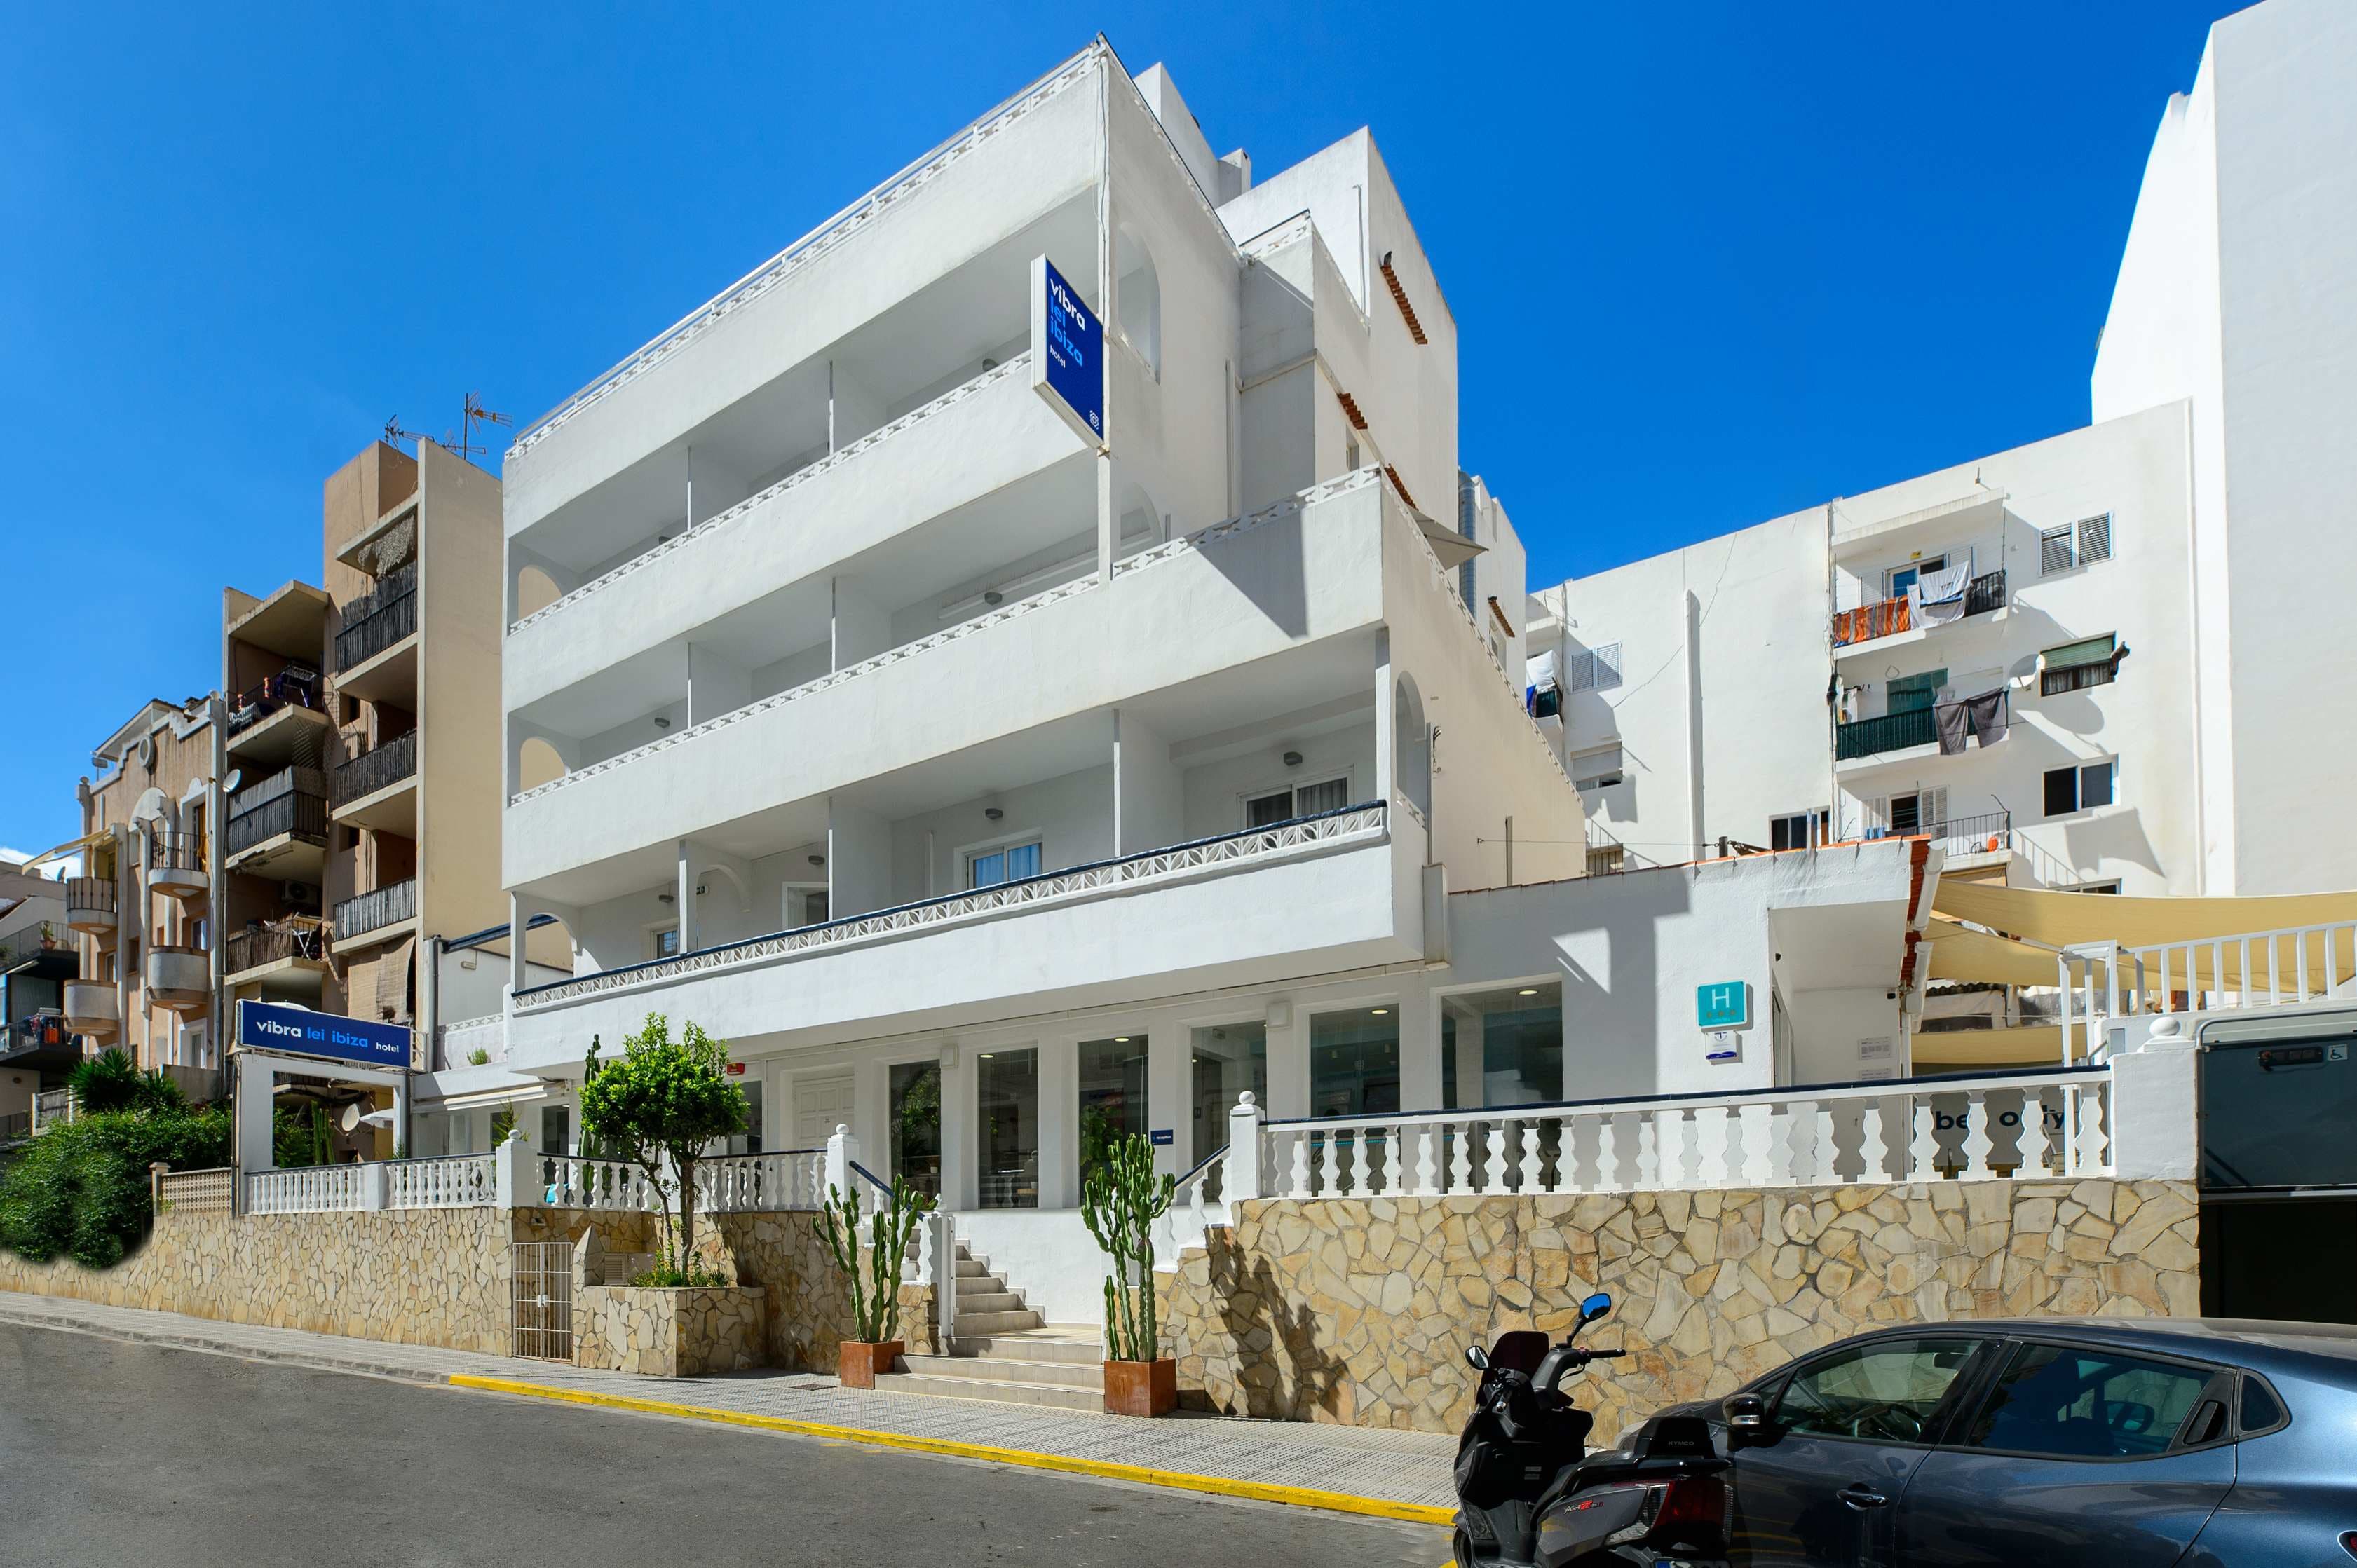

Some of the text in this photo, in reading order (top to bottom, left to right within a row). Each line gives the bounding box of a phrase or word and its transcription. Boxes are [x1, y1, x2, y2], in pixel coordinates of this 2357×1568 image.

[1050, 279, 1085, 332] vibra
[1051, 295, 1066, 328] lei
[1050, 345, 1066, 369] hotel
[1051, 317, 1082, 367] ibiza
[1711, 987, 1730, 1010] H
[256, 1020, 399, 1053] vibra lei ibiza hotel
